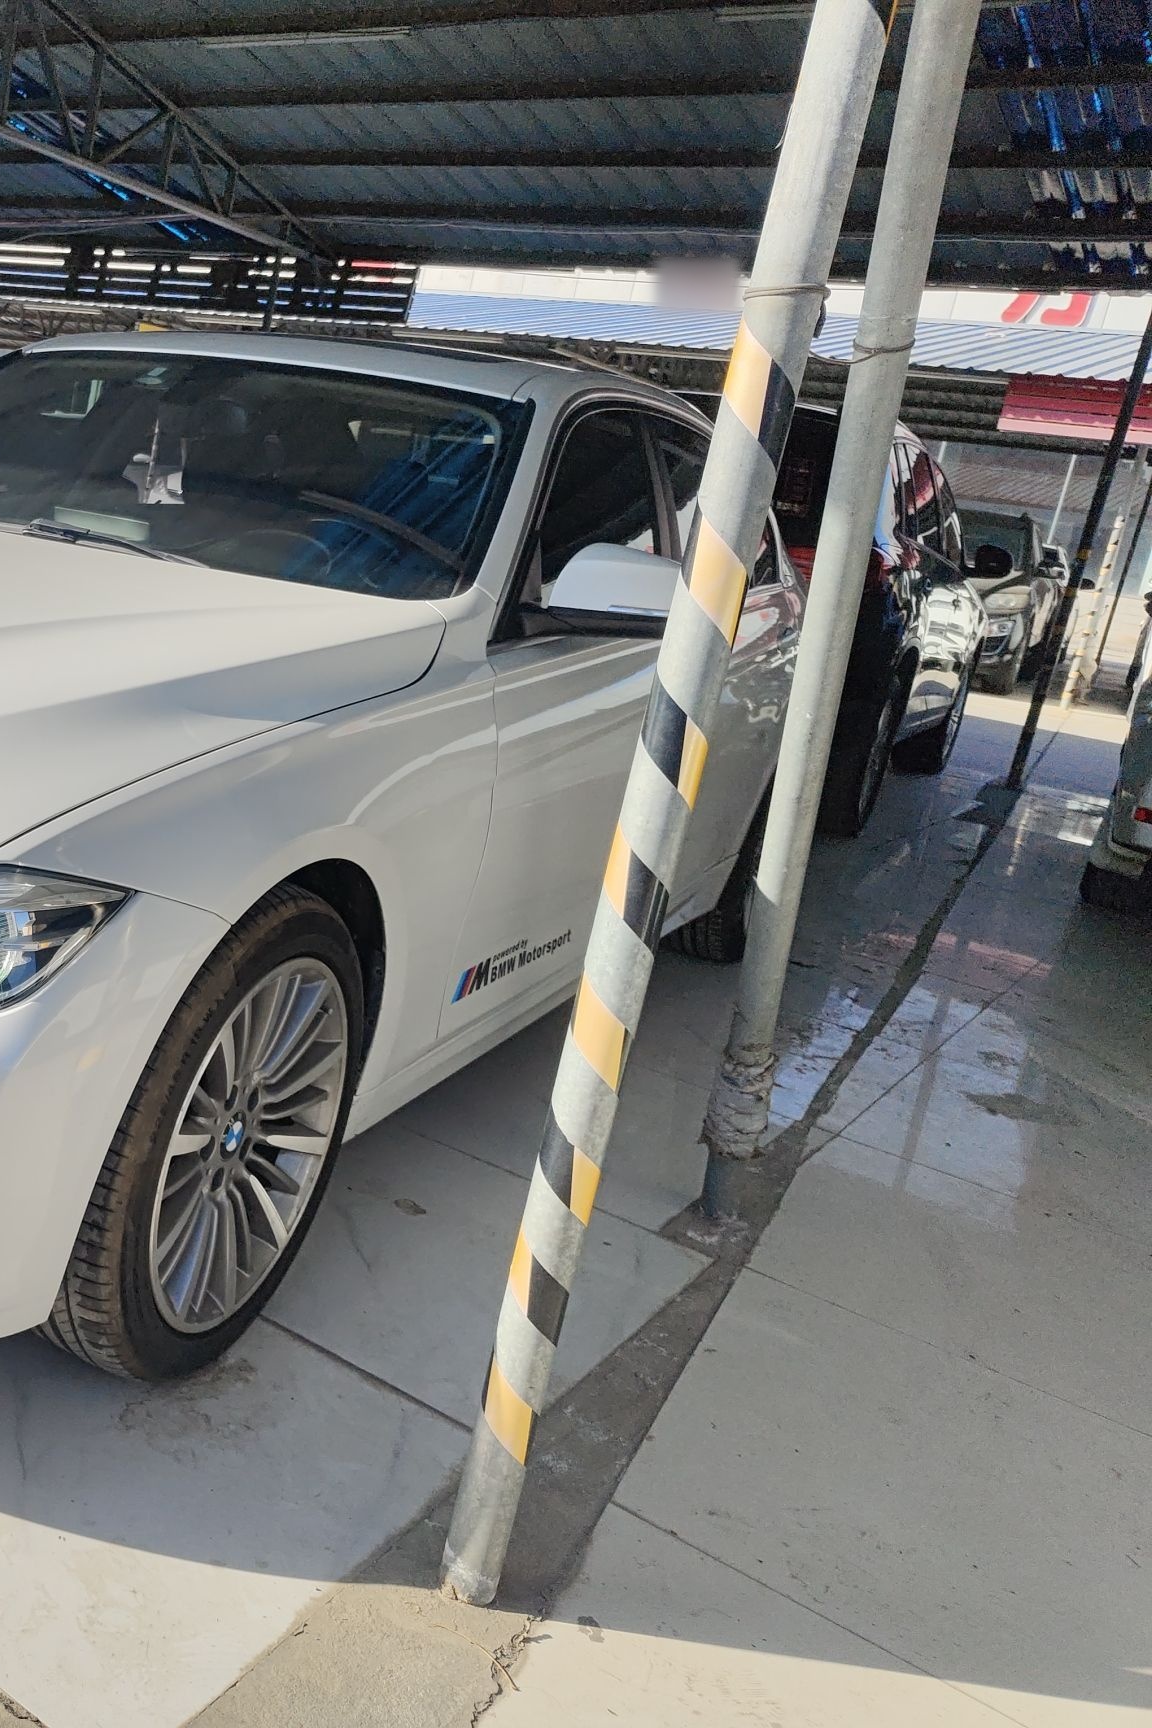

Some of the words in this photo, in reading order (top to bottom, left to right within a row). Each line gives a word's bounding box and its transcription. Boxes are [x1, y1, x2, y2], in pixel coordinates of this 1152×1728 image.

[490, 956, 517, 983] BMW
[517, 929, 572, 969] Motorsport
[493, 941, 520, 964] powered
[520, 939, 529, 950] by
